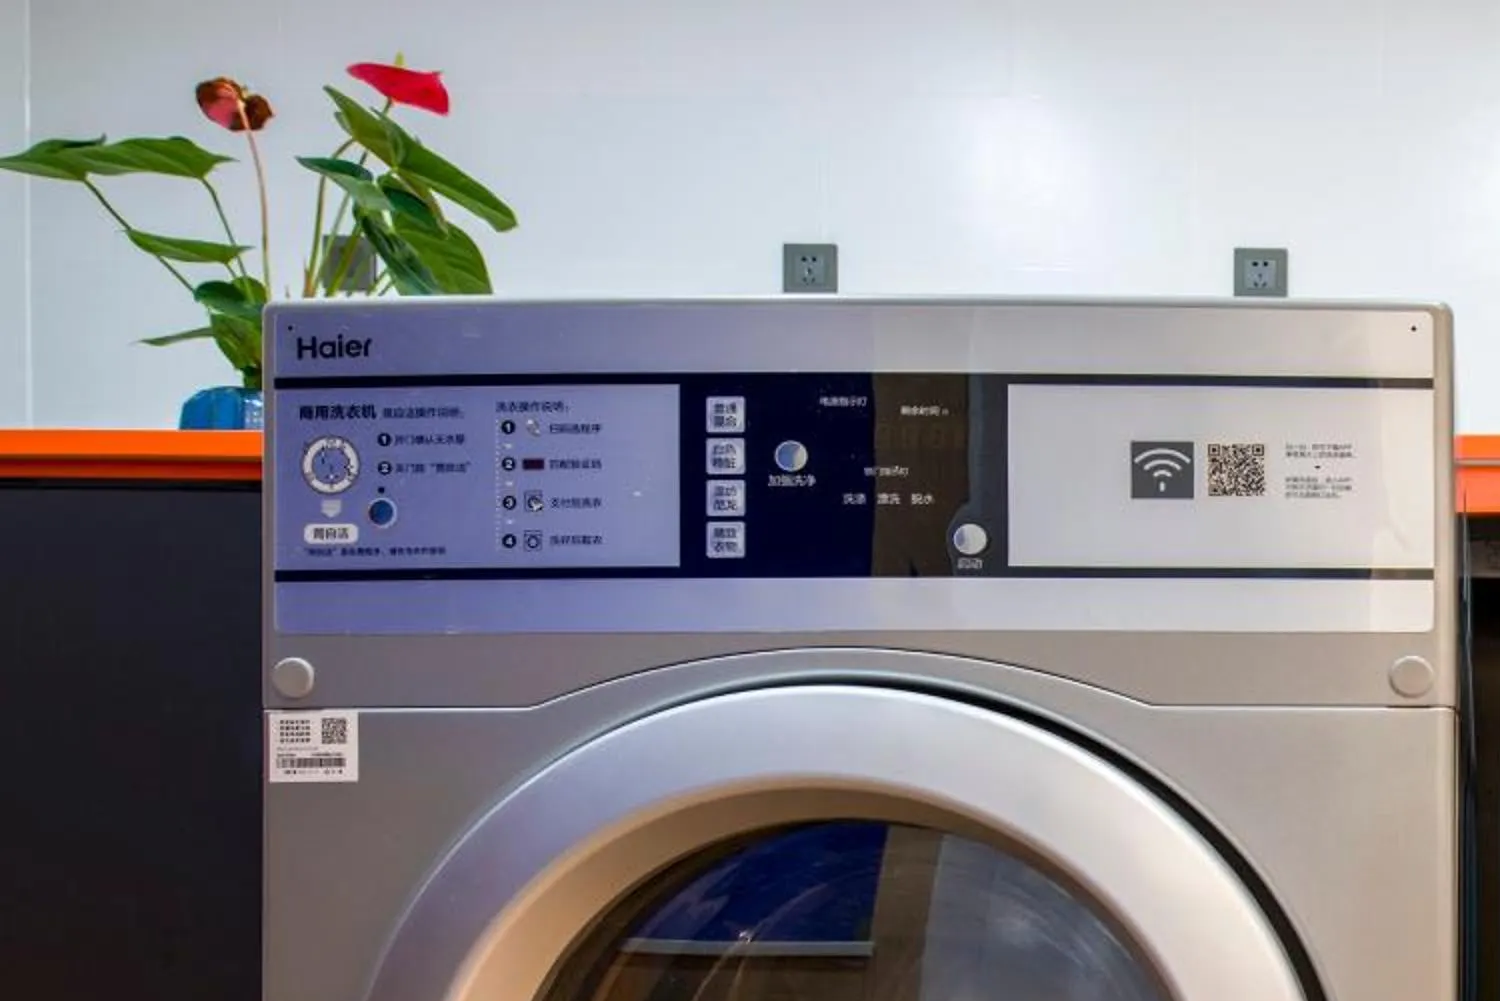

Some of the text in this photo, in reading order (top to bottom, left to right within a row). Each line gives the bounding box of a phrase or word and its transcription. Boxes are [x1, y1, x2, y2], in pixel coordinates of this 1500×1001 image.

[296, 333, 373, 360] Haier
[299, 404, 377, 420] 商用洗衣机
